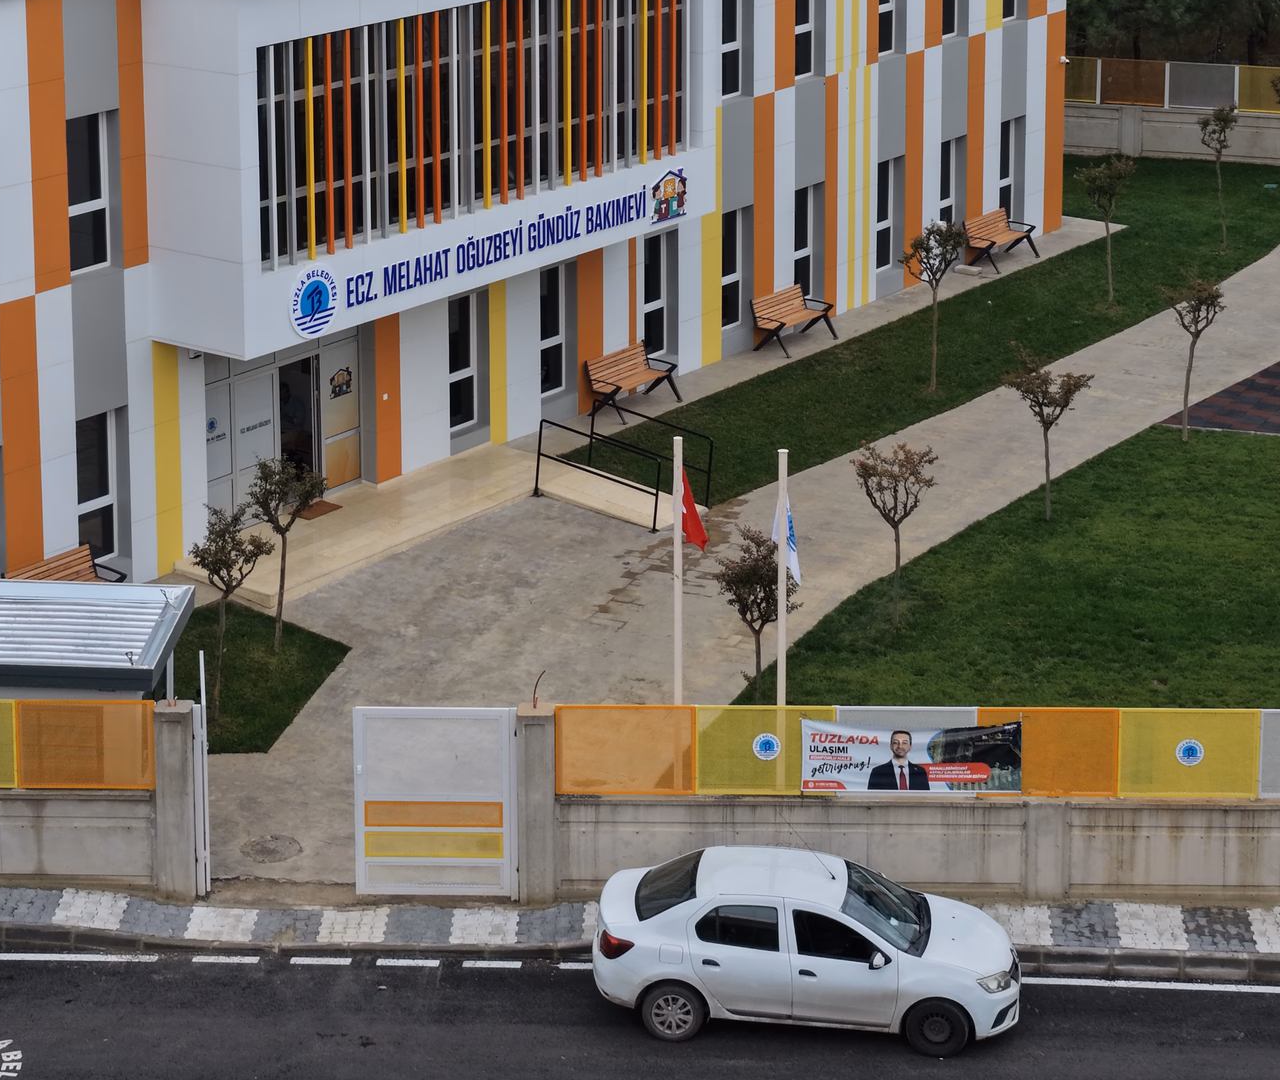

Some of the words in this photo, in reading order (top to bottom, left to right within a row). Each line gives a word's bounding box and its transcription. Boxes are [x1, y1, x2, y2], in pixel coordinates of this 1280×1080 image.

[346, 270, 378, 308] ECZ.
[383, 248, 451, 297] MELAHAT
[456, 219, 523, 274] OĞUZBEYİ
[527, 205, 581, 252] GÜNDÜZ
[585, 184, 647, 235] BAKIMEVİ
[293, 280, 306, 314] TUZLA
[306, 269, 337, 301] BELEDİYESİ
[810, 733, 879, 745] TUZLA'DA
[809, 745, 848, 754] ULAŞIMI
[811, 757, 871, 777] getiriyoruz!
